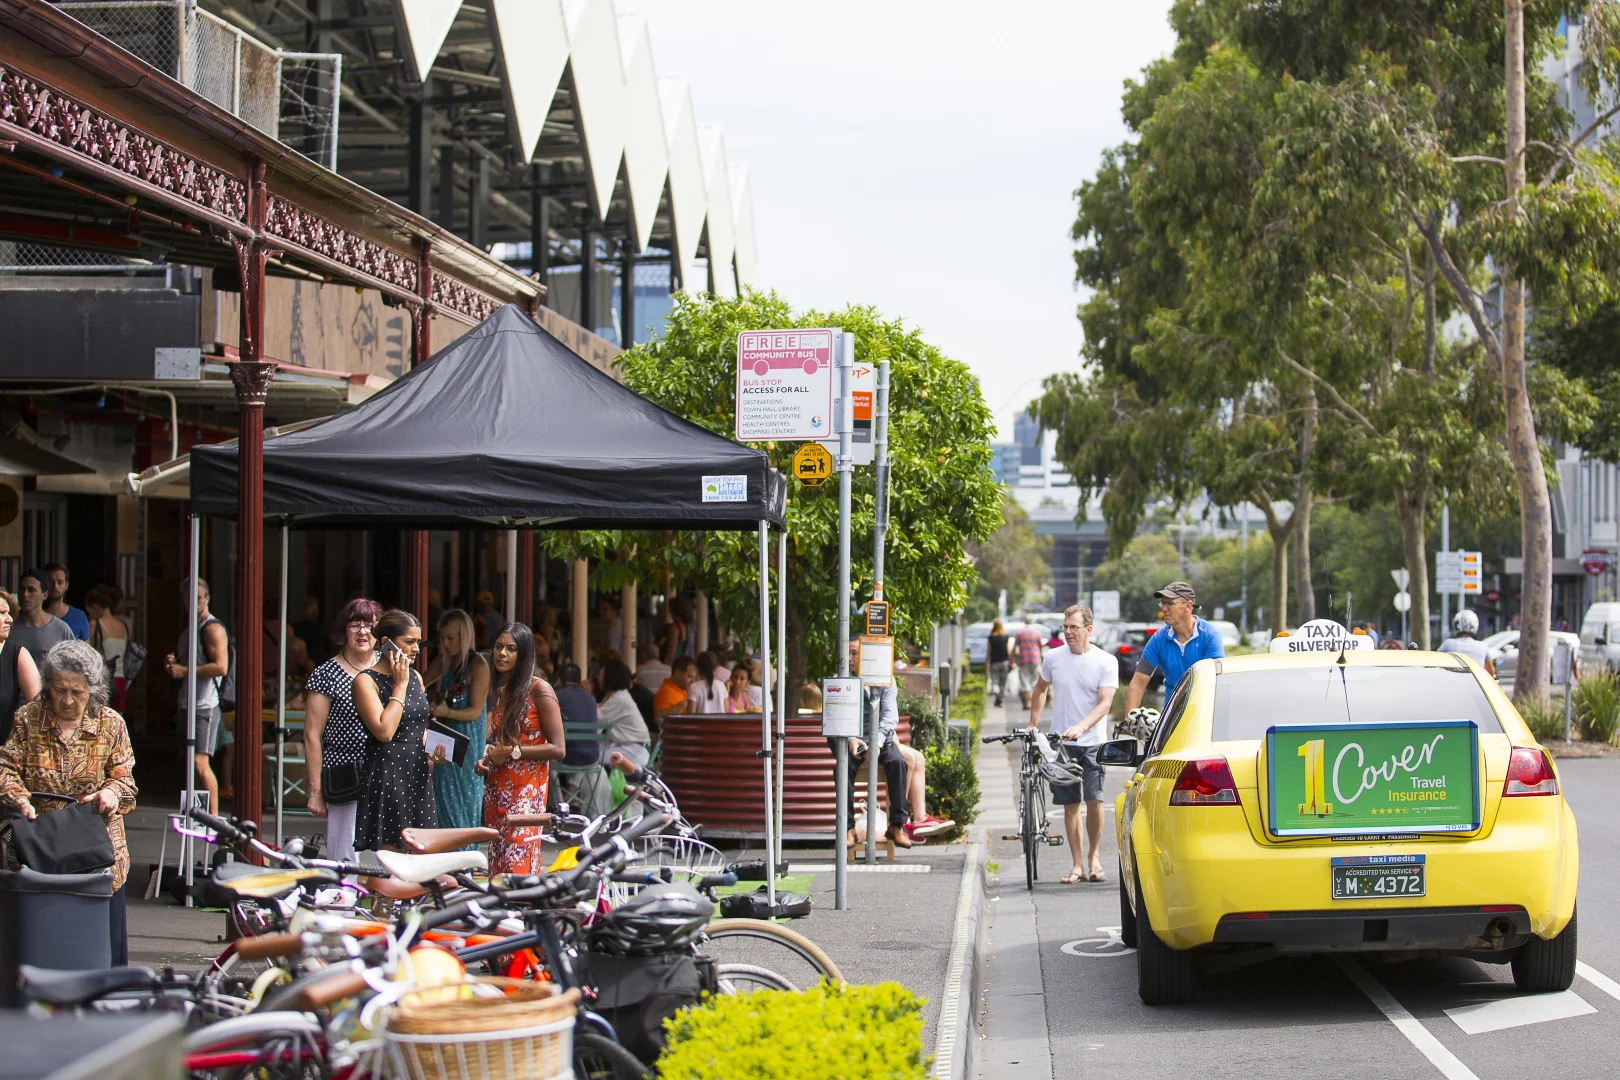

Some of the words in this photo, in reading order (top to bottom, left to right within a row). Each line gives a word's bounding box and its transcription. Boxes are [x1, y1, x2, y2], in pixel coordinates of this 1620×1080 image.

[746, 337, 796, 349] FREE
[744, 351, 796, 360] COMMUNITY
[1304, 624, 1340, 638] TAXI
[1288, 640, 1332, 652] SILVER
[1336, 640, 1359, 651] TOP
[1410, 775, 1446, 789] Travel
[1388, 790, 1446, 802] Insurance
[1346, 878, 1358, 894] M
[1374, 876, 1420, 893] 4372
